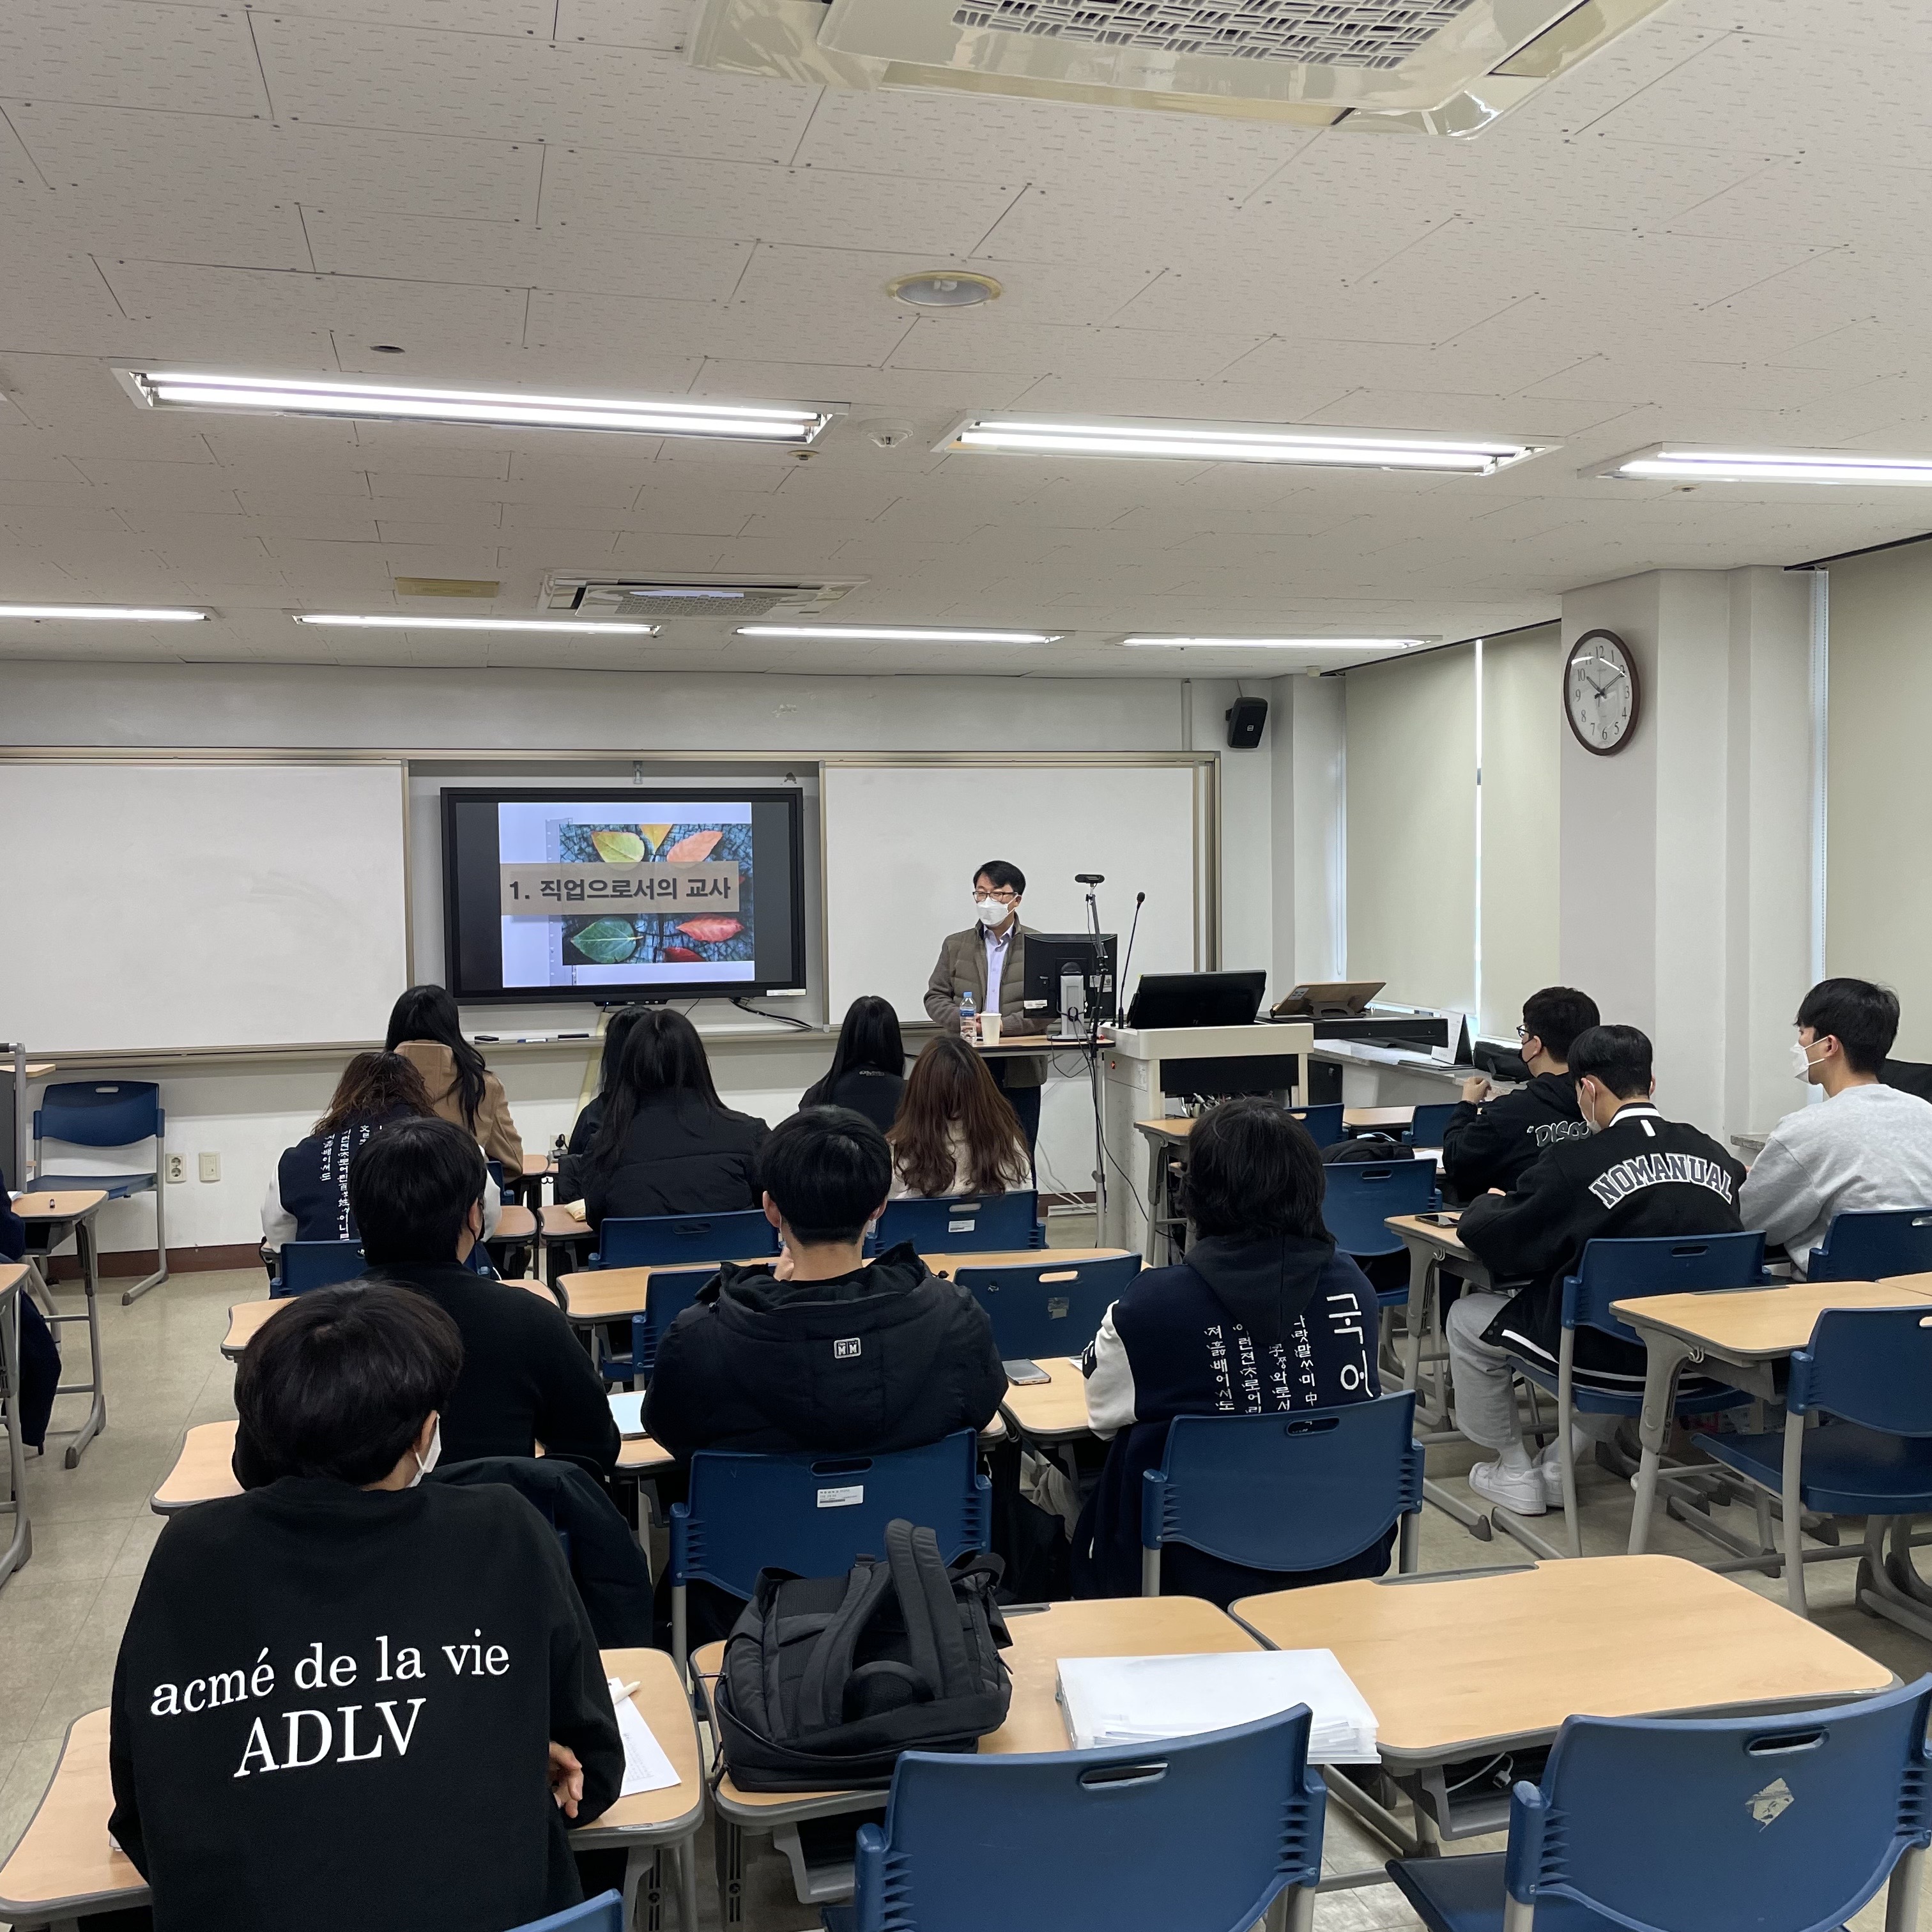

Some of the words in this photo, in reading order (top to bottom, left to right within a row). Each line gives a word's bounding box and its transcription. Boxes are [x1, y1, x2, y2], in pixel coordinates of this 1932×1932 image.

[1584, 652, 1593, 666] 11
[1595, 645, 1606, 659] 12
[1610, 649, 1615, 663] 1
[1577, 668, 1586, 682] 10
[1575, 689, 1581, 702] 9
[1625, 685, 1630, 700] 3
[1581, 709, 1587, 723] 8
[1621, 706, 1628, 720] 4
[1590, 723, 1595, 736] 7
[1602, 726, 1608, 740] 6
[1614, 721, 1620, 735] 5
[509, 881, 530, 900] 1.
[540, 878, 677, 901] 직업으로서의
[686, 877, 731, 900] 교사
[1588, 1153, 1733, 1209] NOMANUAL
[150, 1647, 275, 1716] acmé
[295, 1642, 357, 1690] de
[376, 1635, 426, 1682] la
[441, 1629, 510, 1676] vie
[233, 1698, 426, 1779] ADLV
